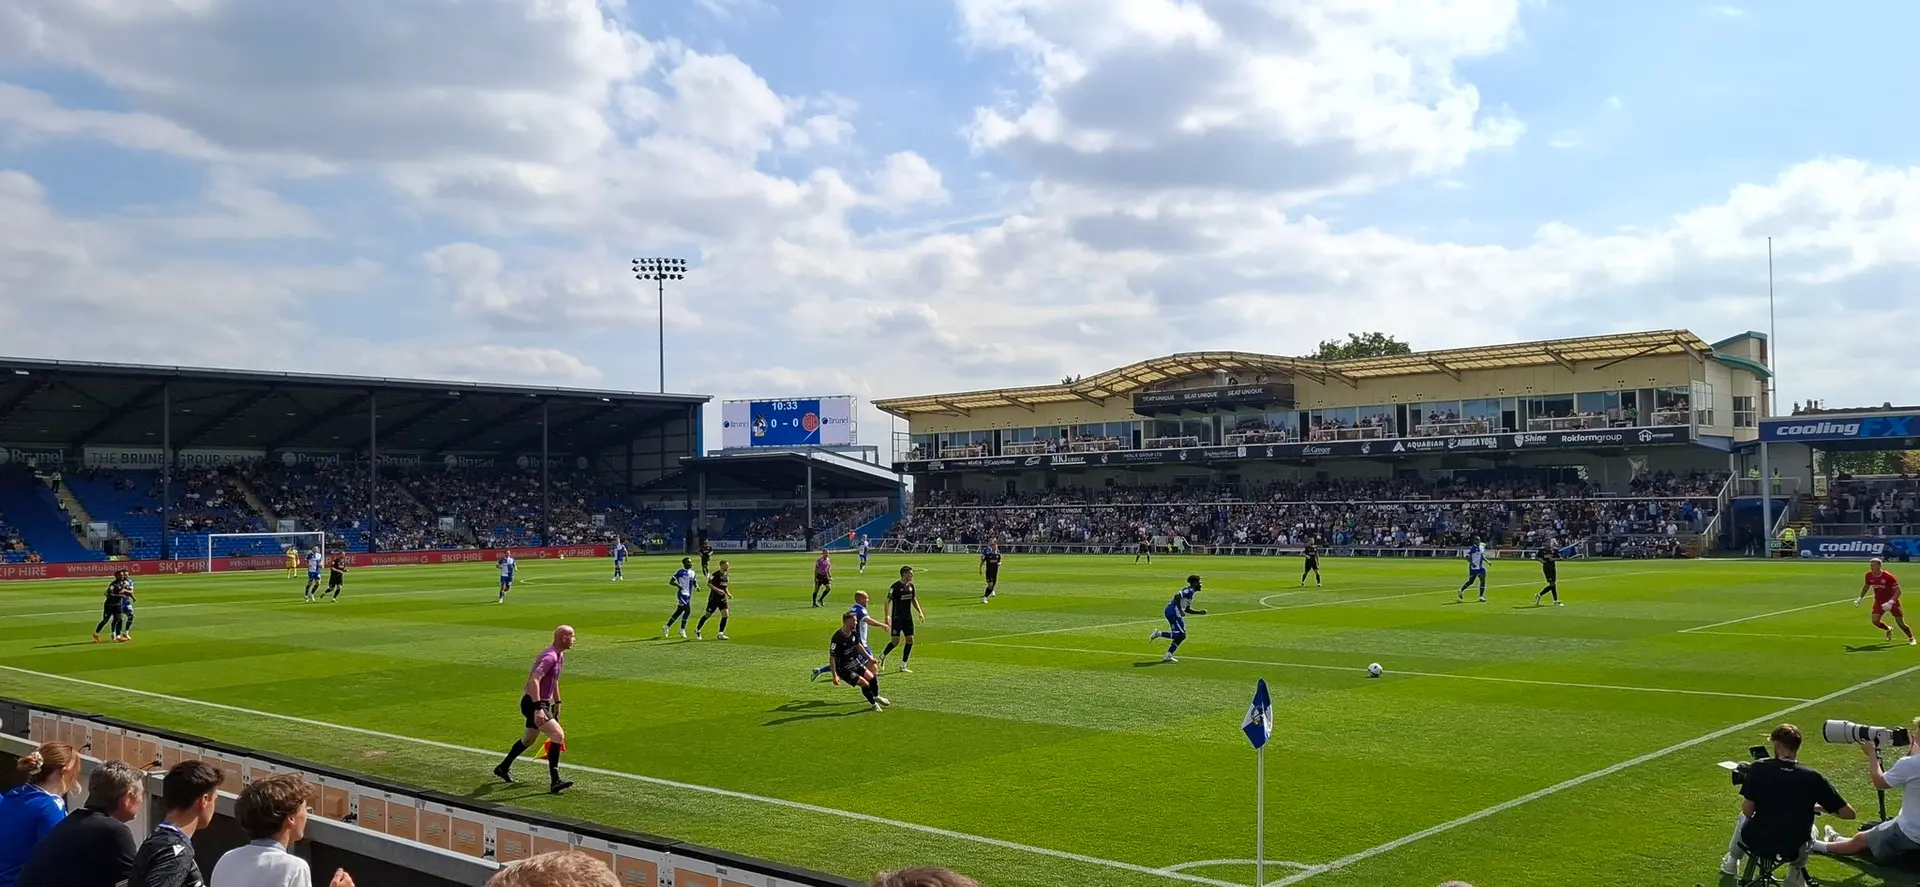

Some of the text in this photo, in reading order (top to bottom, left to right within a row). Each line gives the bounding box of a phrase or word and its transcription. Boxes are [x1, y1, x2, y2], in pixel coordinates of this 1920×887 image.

[772, 401, 798, 410] 10:33
[771, 419, 777, 428] 0
[793, 418, 799, 427] 0
[1776, 416, 1913, 436] cooling FX
[1480, 437, 1498, 446] YOGA
[1525, 434, 1547, 442] Shine
[1407, 440, 1444, 448] AQUARIAN
[92, 452, 117, 463] THE
[577, 548, 595, 556] HIRE
[1819, 541, 1885, 554] cooling
[442, 553, 482, 562] SKIP HIRE
[19, 566, 48, 576] HIRE
